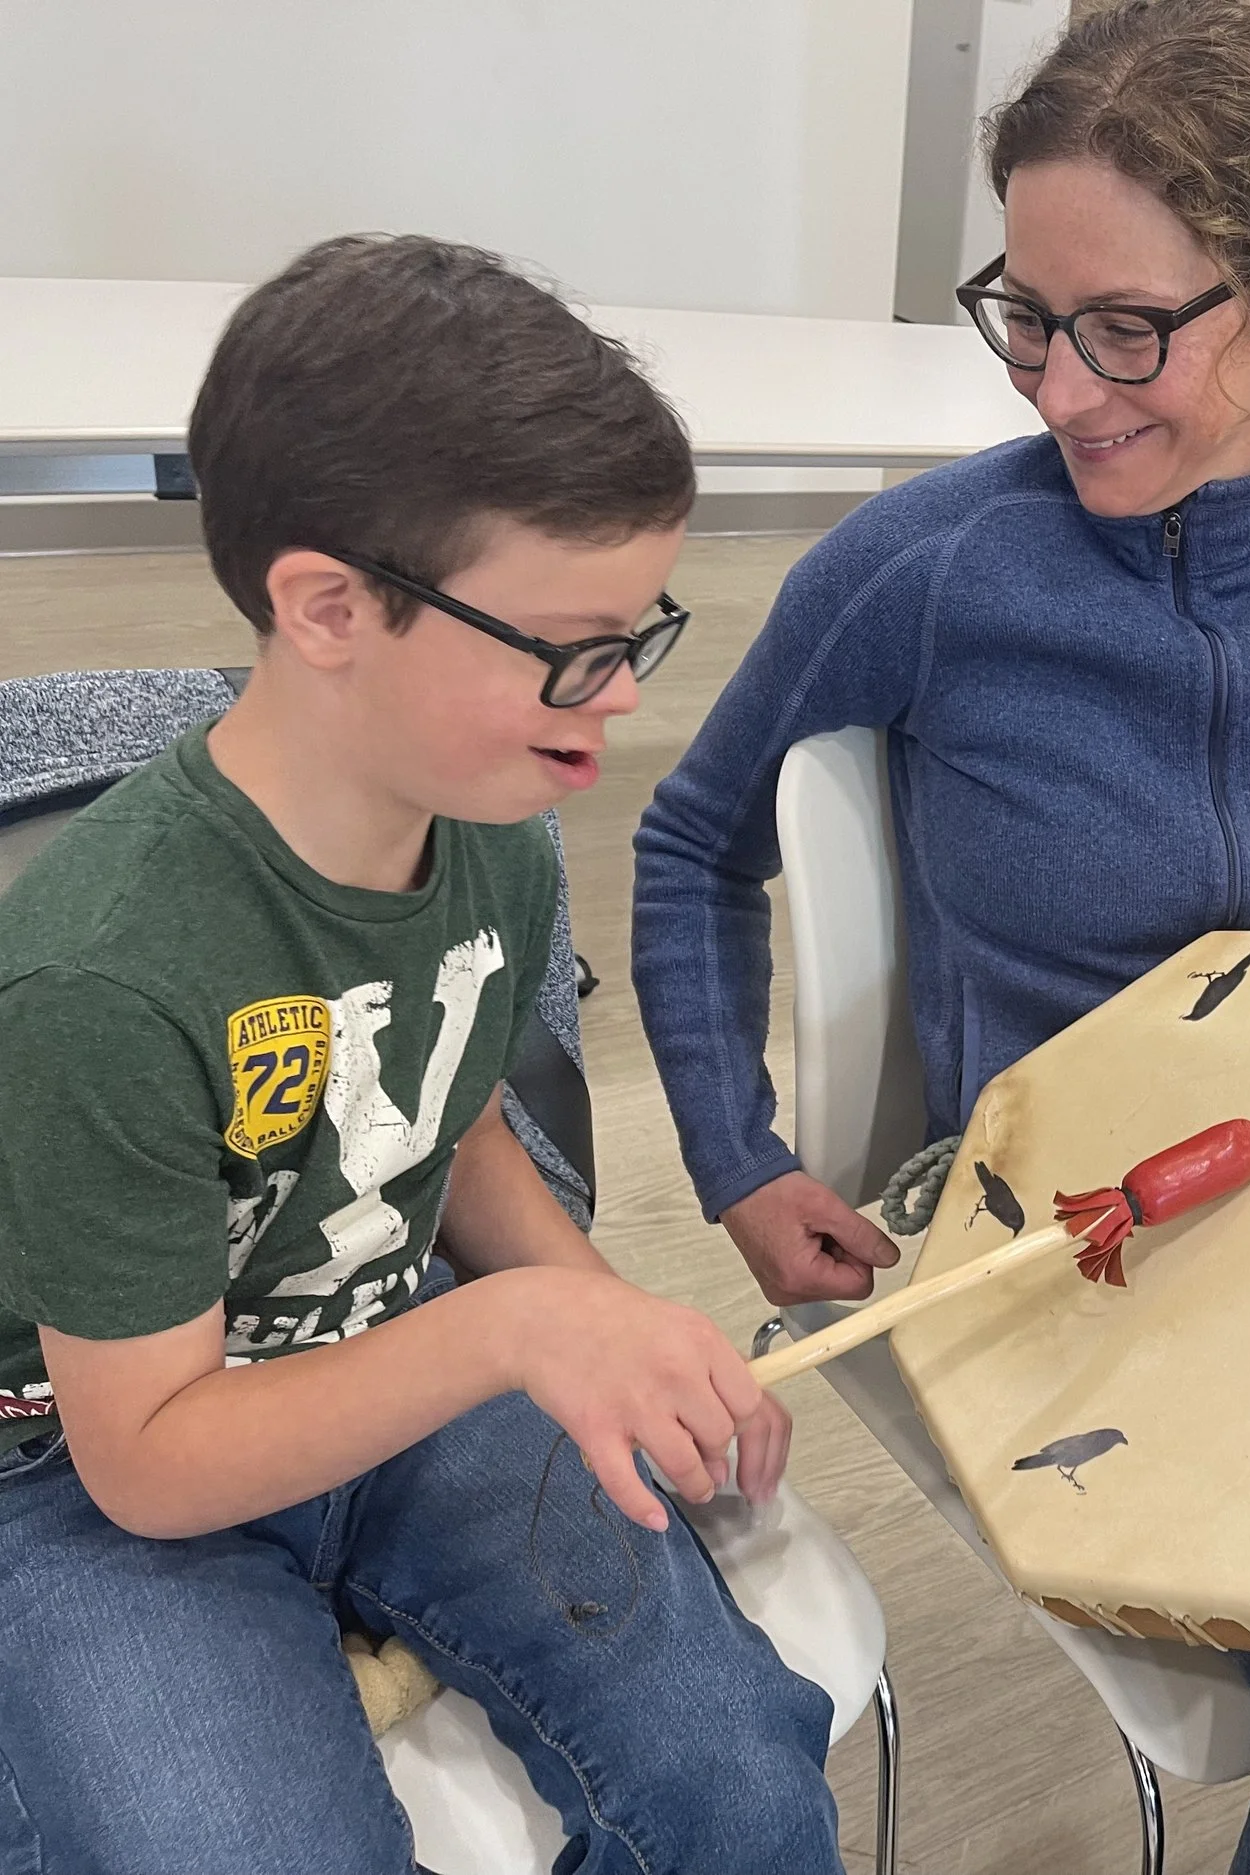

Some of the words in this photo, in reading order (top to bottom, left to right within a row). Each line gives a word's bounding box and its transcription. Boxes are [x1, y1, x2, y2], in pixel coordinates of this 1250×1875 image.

[238, 1006, 323, 1047] ATHLETIC
[242, 1045, 310, 1114] 72
[257, 1123, 296, 1145] BALL
[298, 1084, 316, 1123] CLUB
